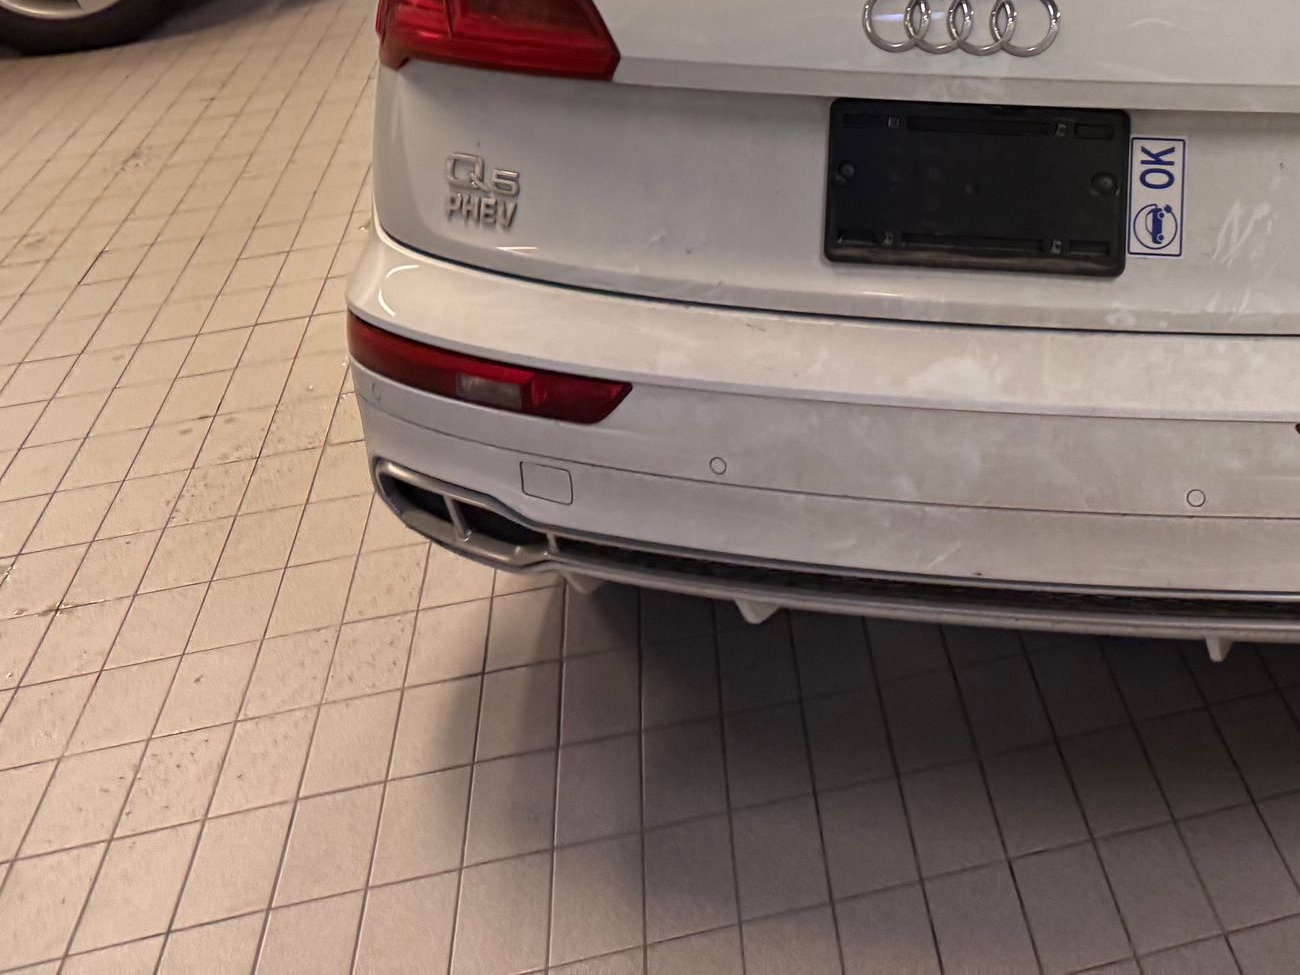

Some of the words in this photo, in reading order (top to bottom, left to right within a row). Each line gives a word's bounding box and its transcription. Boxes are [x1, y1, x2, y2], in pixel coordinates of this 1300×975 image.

[446, 152, 520, 198] Q5
[1140, 146, 1175, 189] OK
[446, 194, 518, 230] PHEV
